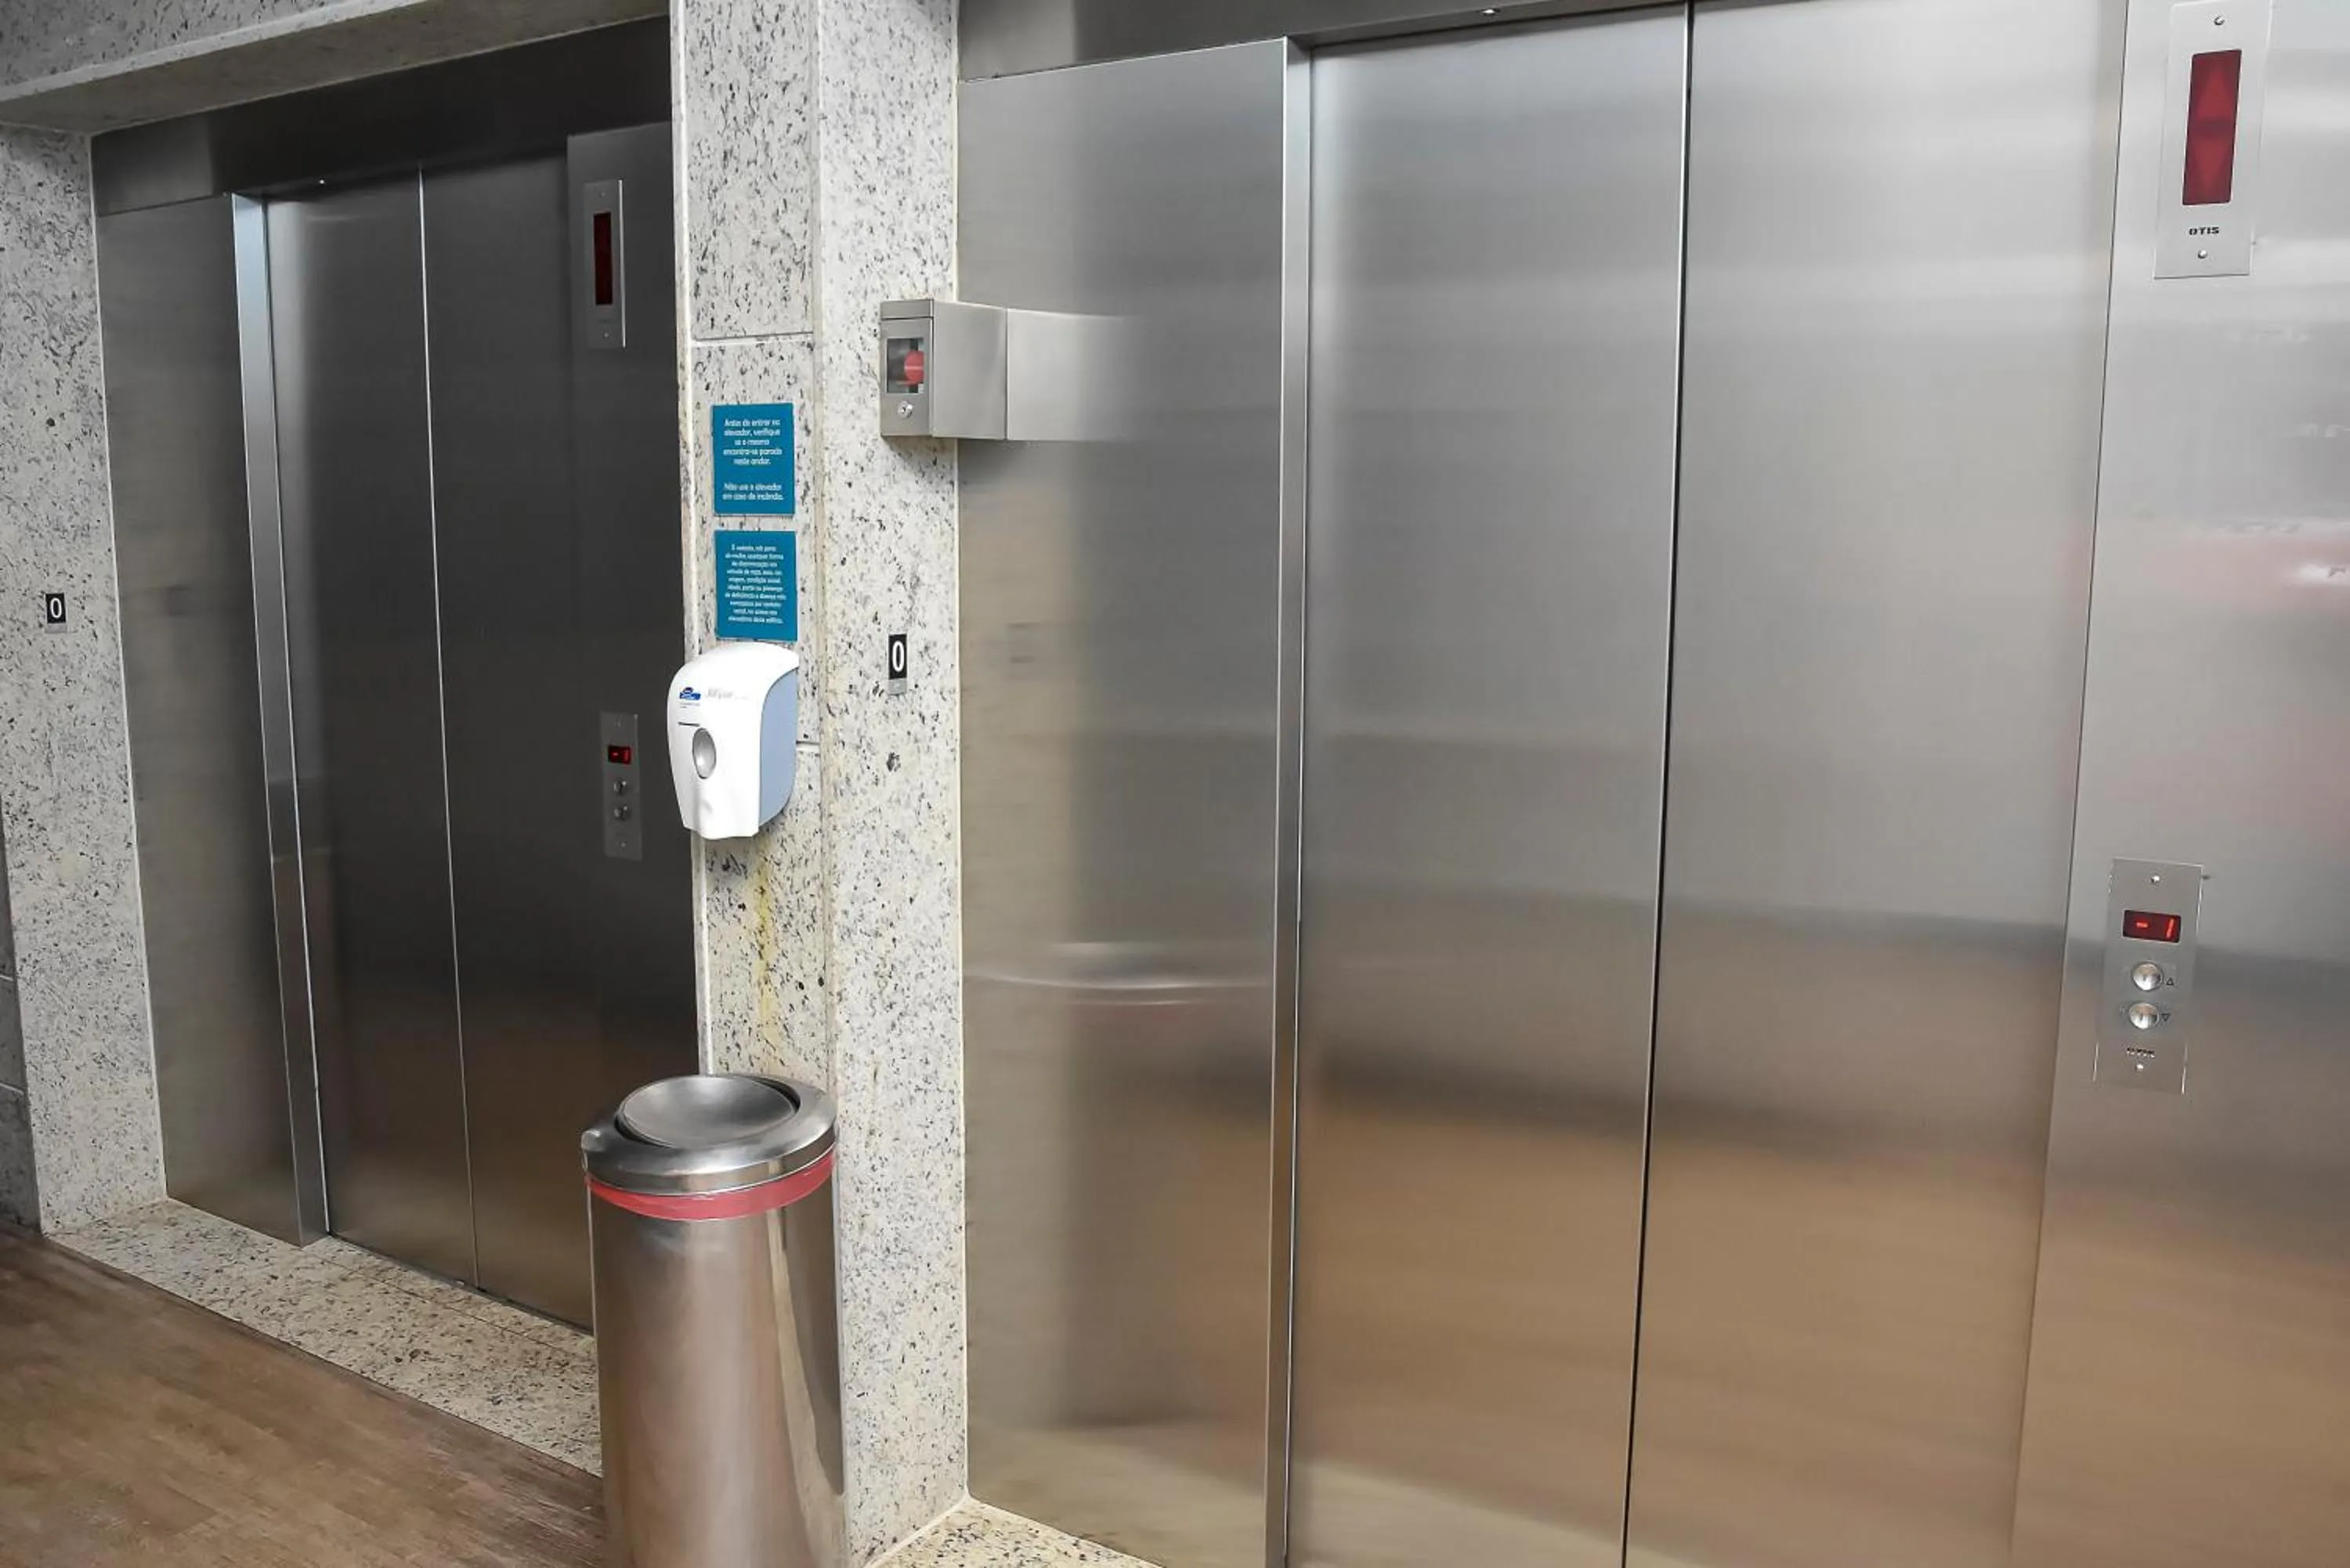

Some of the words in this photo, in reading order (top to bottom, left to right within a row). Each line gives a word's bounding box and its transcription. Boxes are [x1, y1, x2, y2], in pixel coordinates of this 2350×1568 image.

[2189, 226, 2219, 236] OTIS
[50, 598, 62, 618] 0
[892, 640, 905, 672] 0
